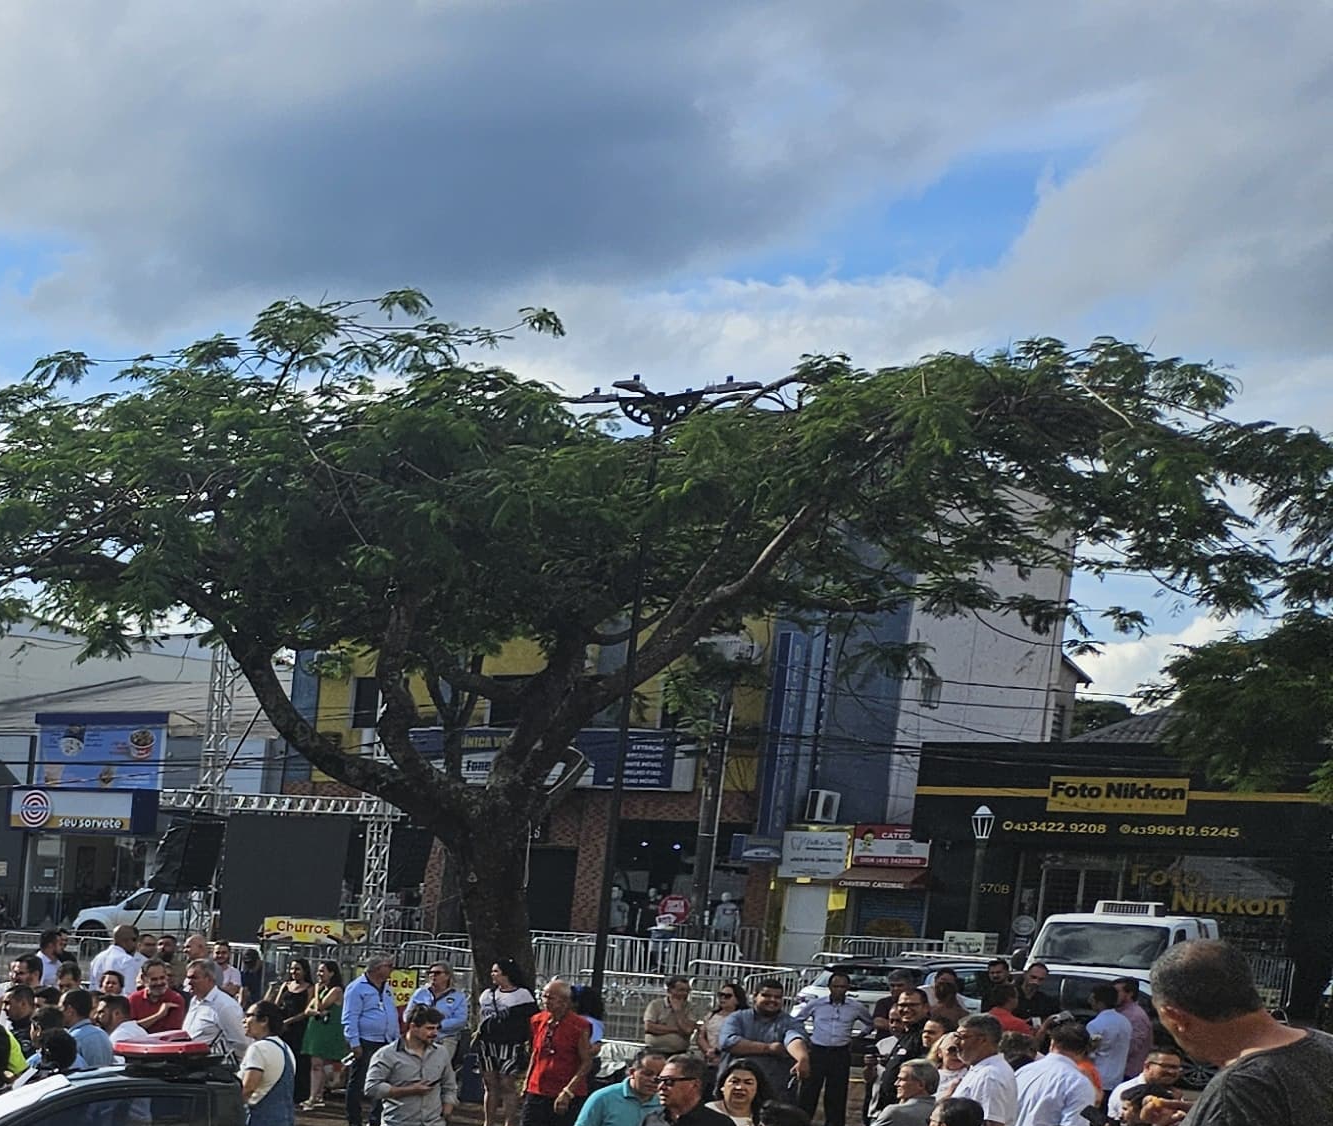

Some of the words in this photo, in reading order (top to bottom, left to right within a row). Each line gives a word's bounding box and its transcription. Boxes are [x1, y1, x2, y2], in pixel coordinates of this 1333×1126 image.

[1050, 781, 1100, 799] Foto
[1105, 782, 1186, 800] Nikkon
[58, 816, 79, 829] seu
[80, 816, 123, 829] sorvete
[1131, 864, 1204, 886] Foto
[979, 882, 1011, 895] 570B
[1171, 889, 1286, 916] Nikkon
[276, 920, 332, 935] Churros
[400, 978, 414, 988] de
